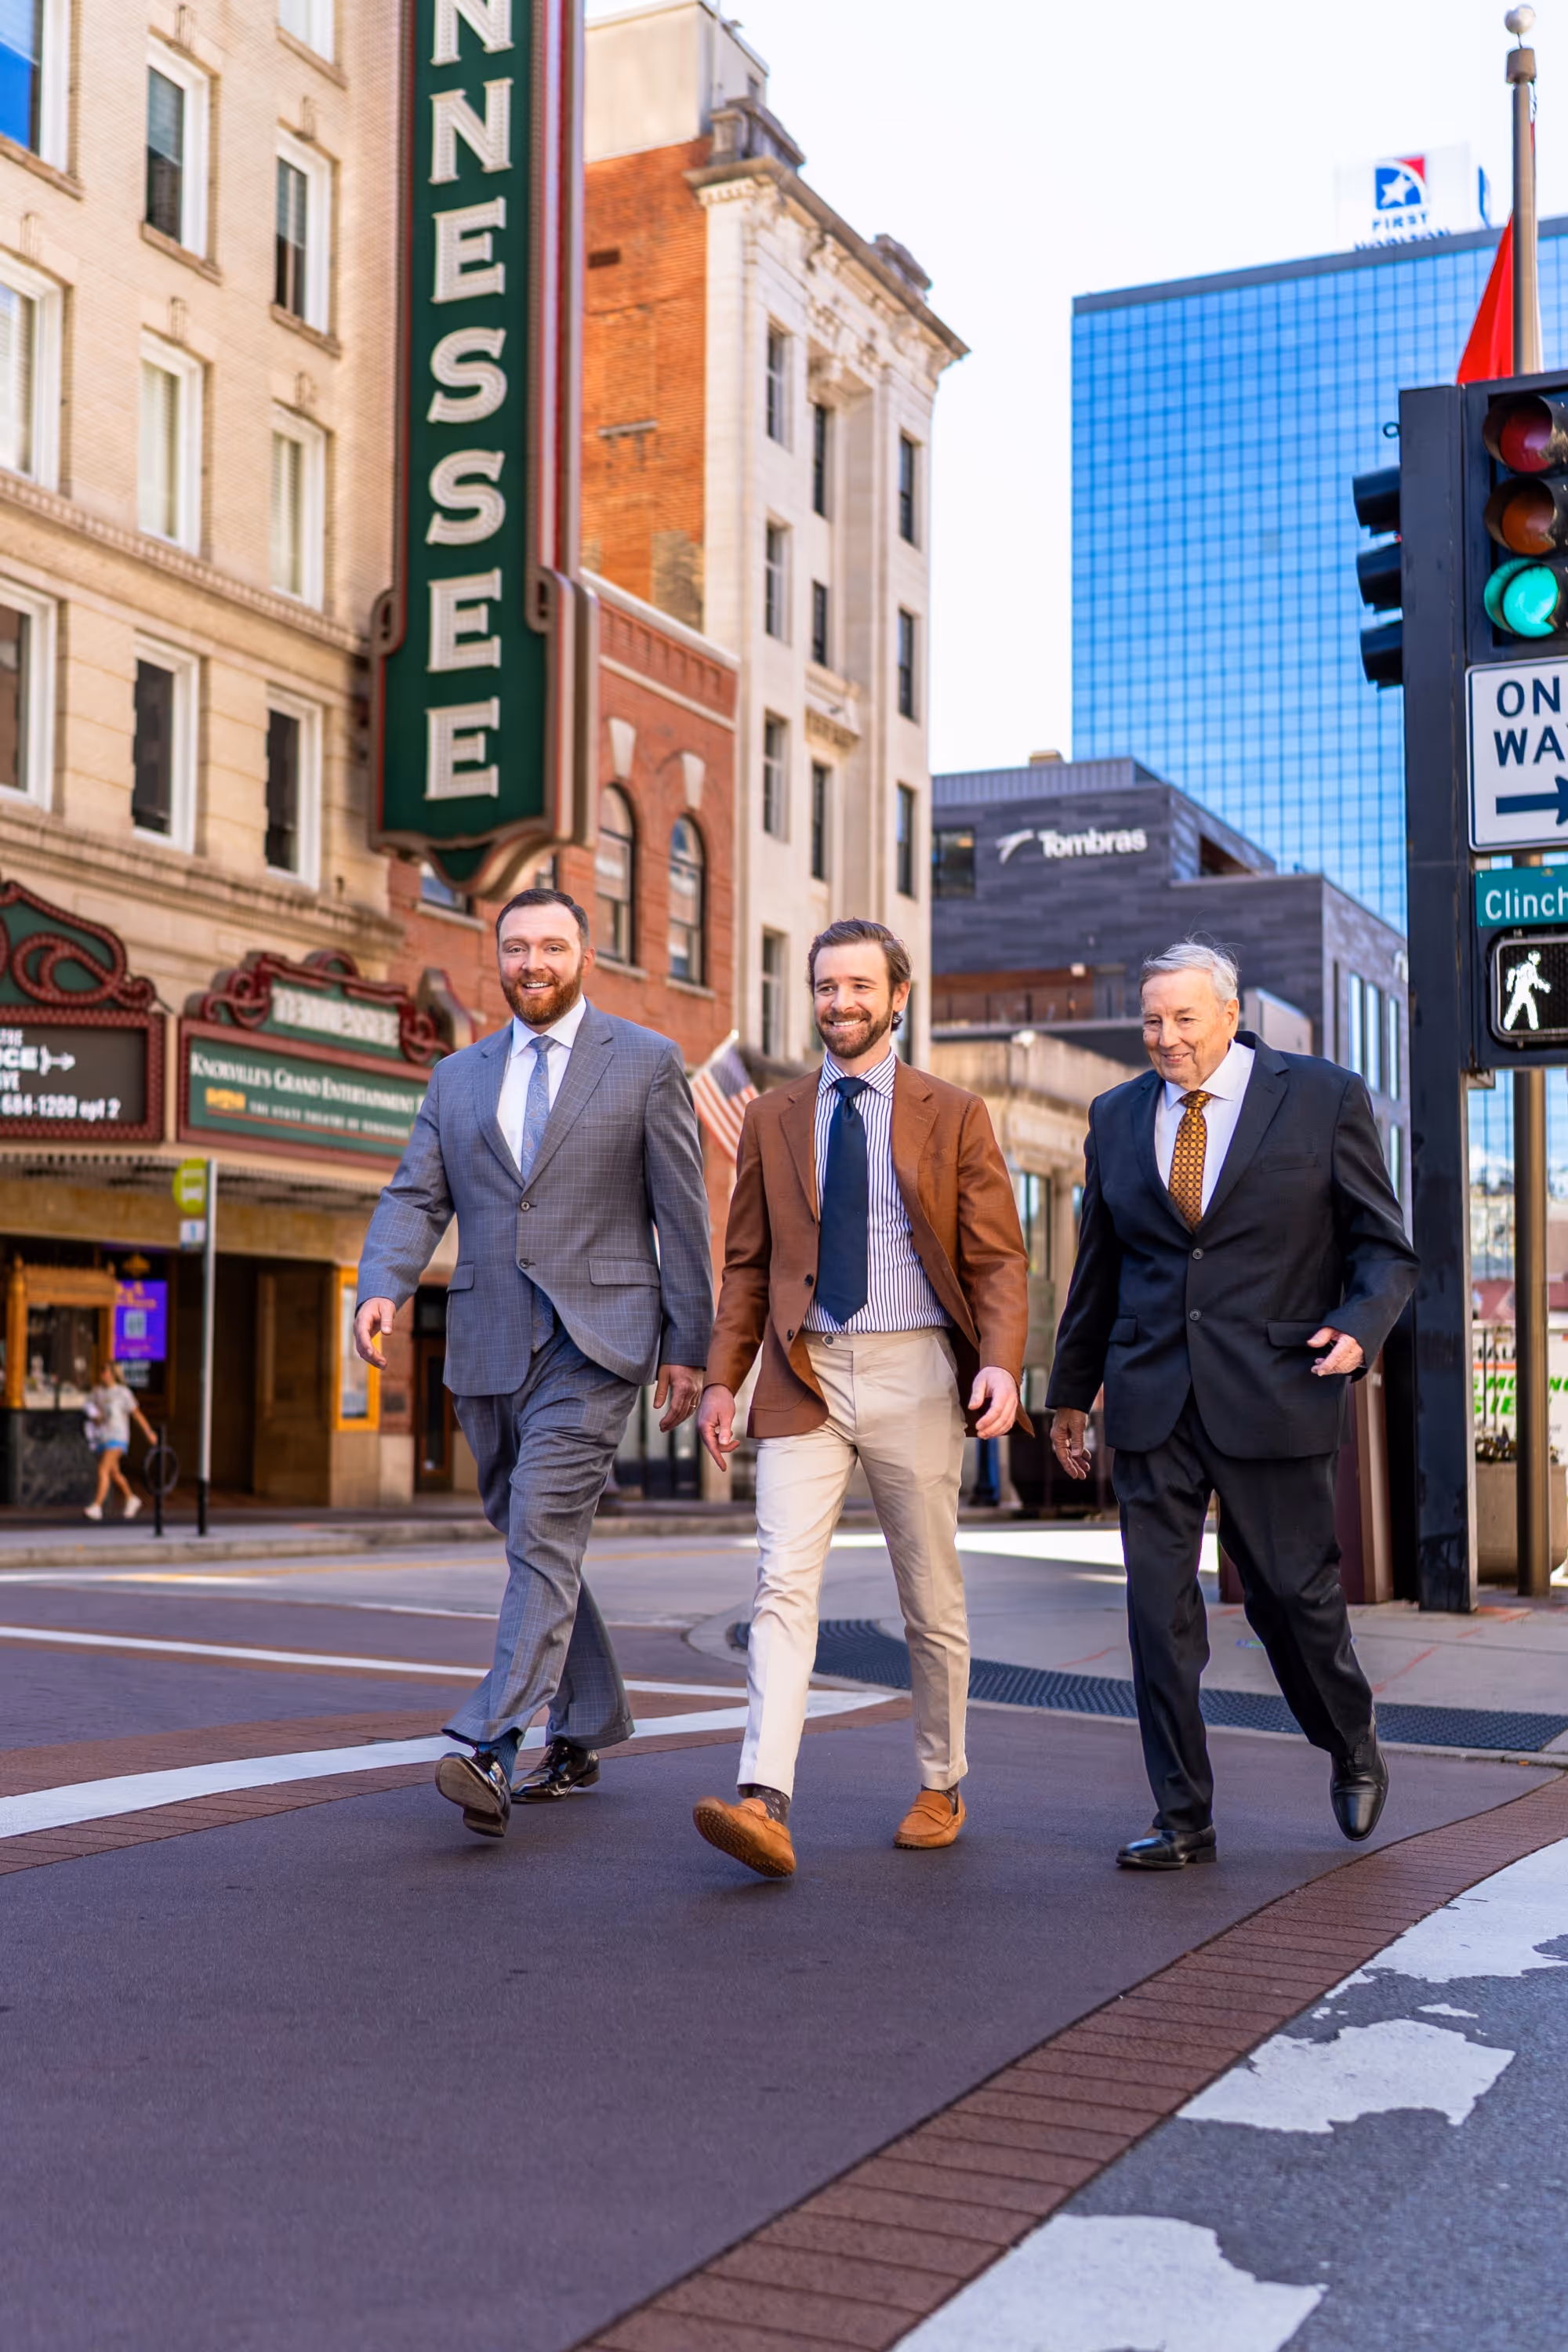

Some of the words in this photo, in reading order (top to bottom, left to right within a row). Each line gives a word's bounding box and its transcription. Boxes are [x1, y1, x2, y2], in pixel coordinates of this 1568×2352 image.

[1372, 211, 1428, 232] FIRST
[1494, 724, 1568, 768] WA
[1038, 827, 1147, 857] Tombras
[1485, 885, 1568, 920] Clinch
